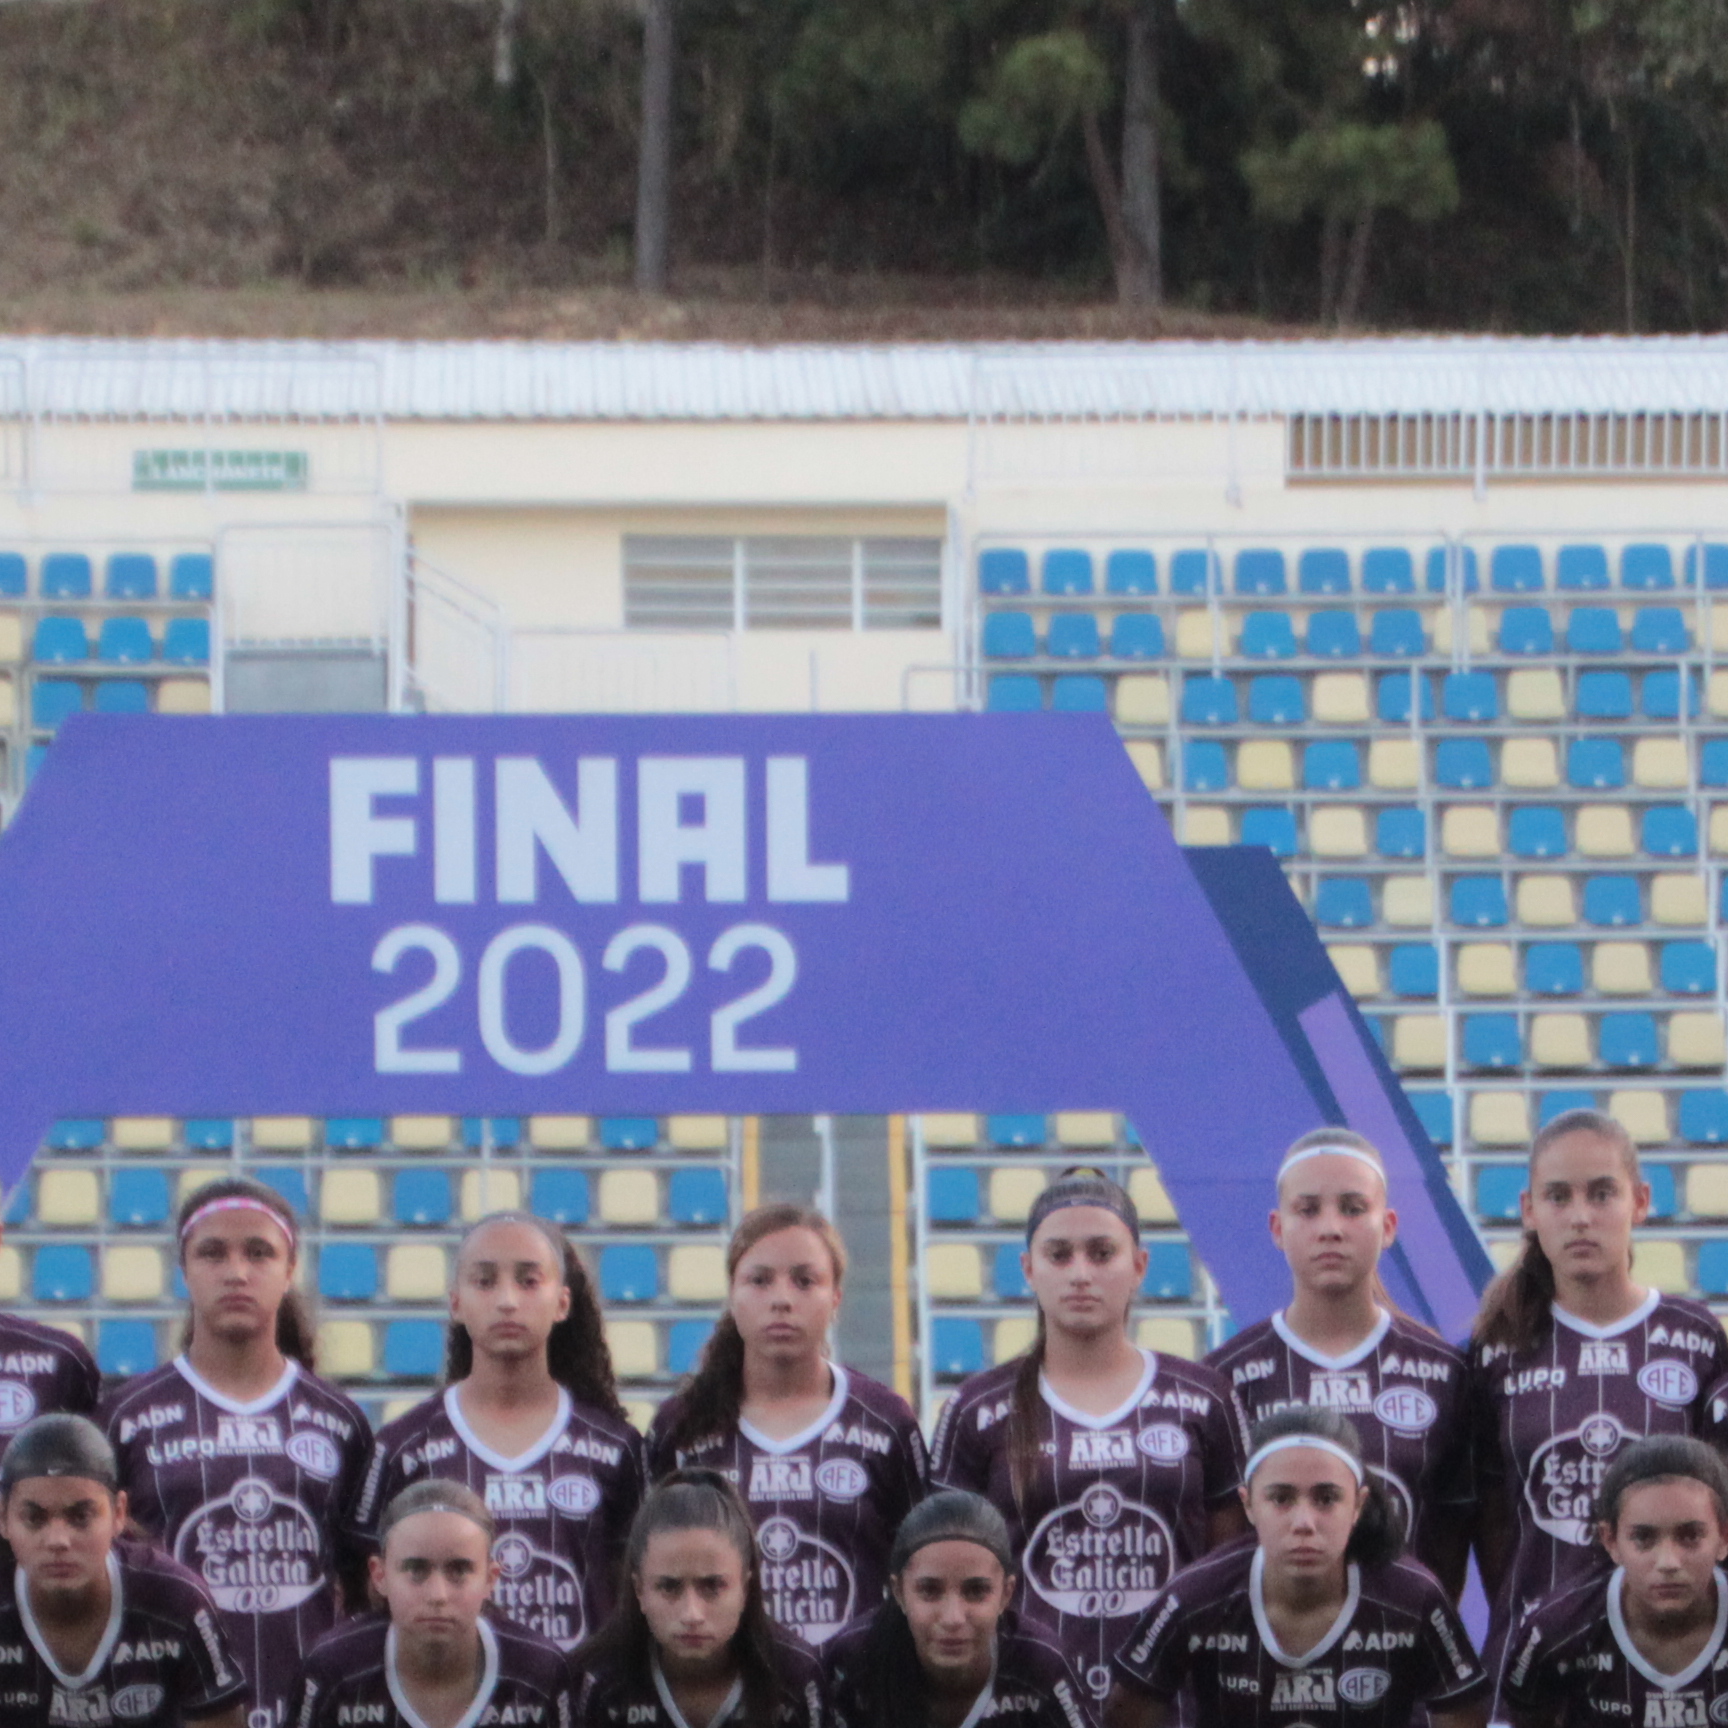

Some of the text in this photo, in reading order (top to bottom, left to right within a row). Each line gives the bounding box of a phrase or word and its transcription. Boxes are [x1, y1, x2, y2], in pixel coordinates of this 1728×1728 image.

[328, 754, 849, 903] FINAL
[370, 922, 799, 1075] 2022
[1578, 1347, 1629, 1370] ARJ
[1670, 1331, 1715, 1358] ADN
[0, 1351, 56, 1375] ADN
[1232, 1359, 1276, 1385] ADN
[1401, 1361, 1449, 1381] ADN
[1309, 1377, 1372, 1406] ARJ
[1503, 1367, 1566, 1394] LUPO
[1643, 1365, 1692, 1396] AFE
[1162, 1389, 1209, 1416] ADN
[1378, 1392, 1433, 1424] AFE
[138, 1405, 184, 1430] ADN
[311, 1407, 352, 1441] ADN
[218, 1422, 283, 1449] ARJ
[844, 1425, 891, 1454] ADN
[1071, 1432, 1134, 1461] ARJ
[147, 1437, 215, 1464] LUPO
[573, 1439, 619, 1466] ADN
[749, 1462, 812, 1491] ARJ
[485, 1481, 547, 1509] ARJ
[196, 1520, 312, 1552] Estrella
[1046, 1527, 1161, 1557] Estrella
[203, 1552, 307, 1587] Galicia
[1051, 1557, 1157, 1590] Galicia
[1129, 1595, 1179, 1665] Unimed
[1363, 1630, 1415, 1650] ADN
[1430, 1607, 1471, 1679] Unimed
[1272, 1674, 1334, 1702] ARJ
[338, 1703, 384, 1725] ADN
[1644, 1699, 1708, 1728] ARJ
